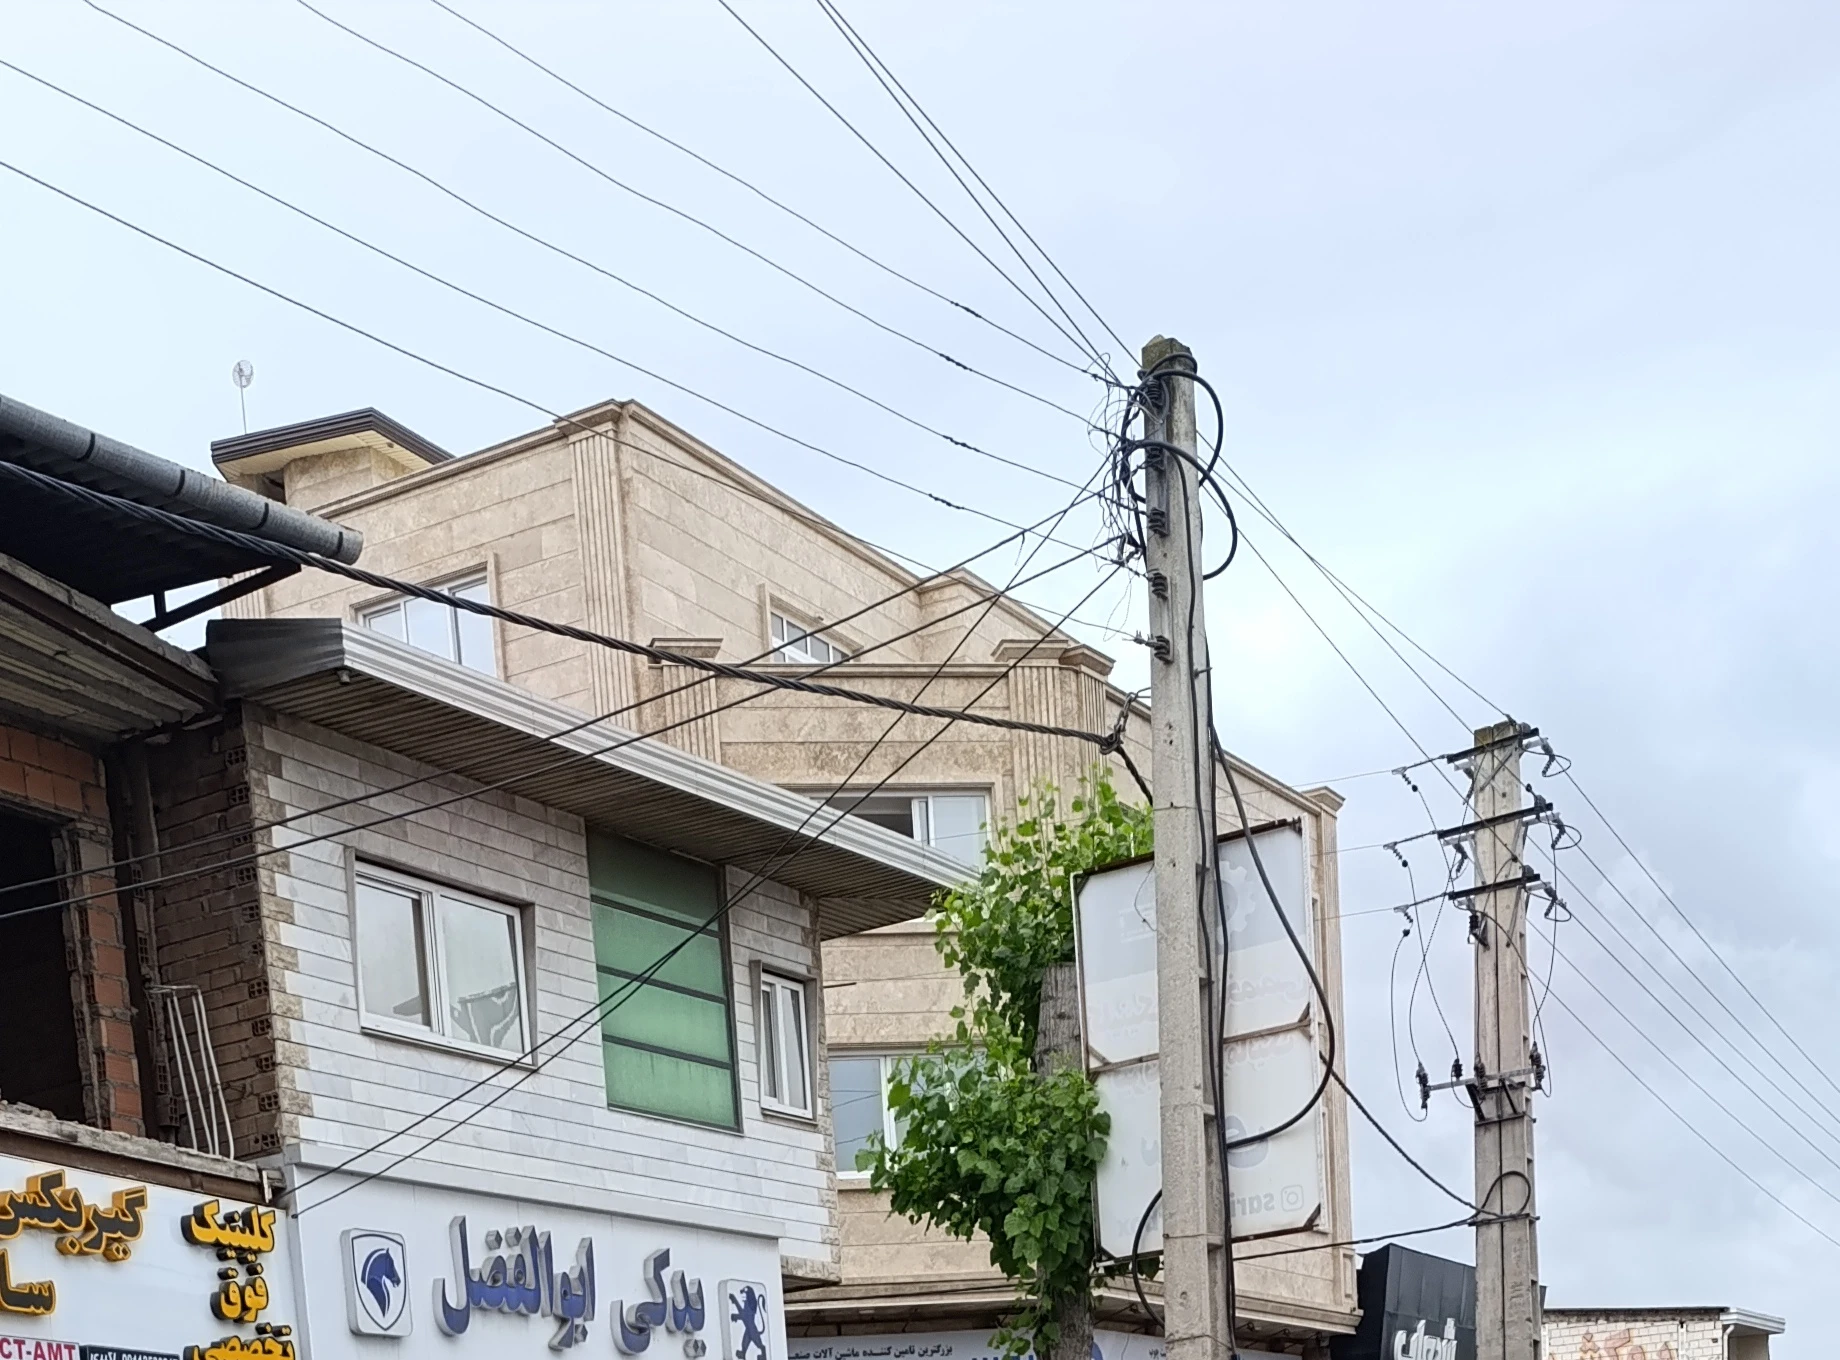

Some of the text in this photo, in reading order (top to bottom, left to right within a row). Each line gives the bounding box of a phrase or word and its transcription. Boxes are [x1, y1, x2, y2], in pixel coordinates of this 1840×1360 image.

[181, 1199, 276, 1265] کلینیک
[211, 1262, 269, 1323] فوق
[432, 1215, 706, 1359] یدکی ابوالفضل
[787, 1343, 953, 1360] بزرگترین تامین کننده ماشین آلات صنع
